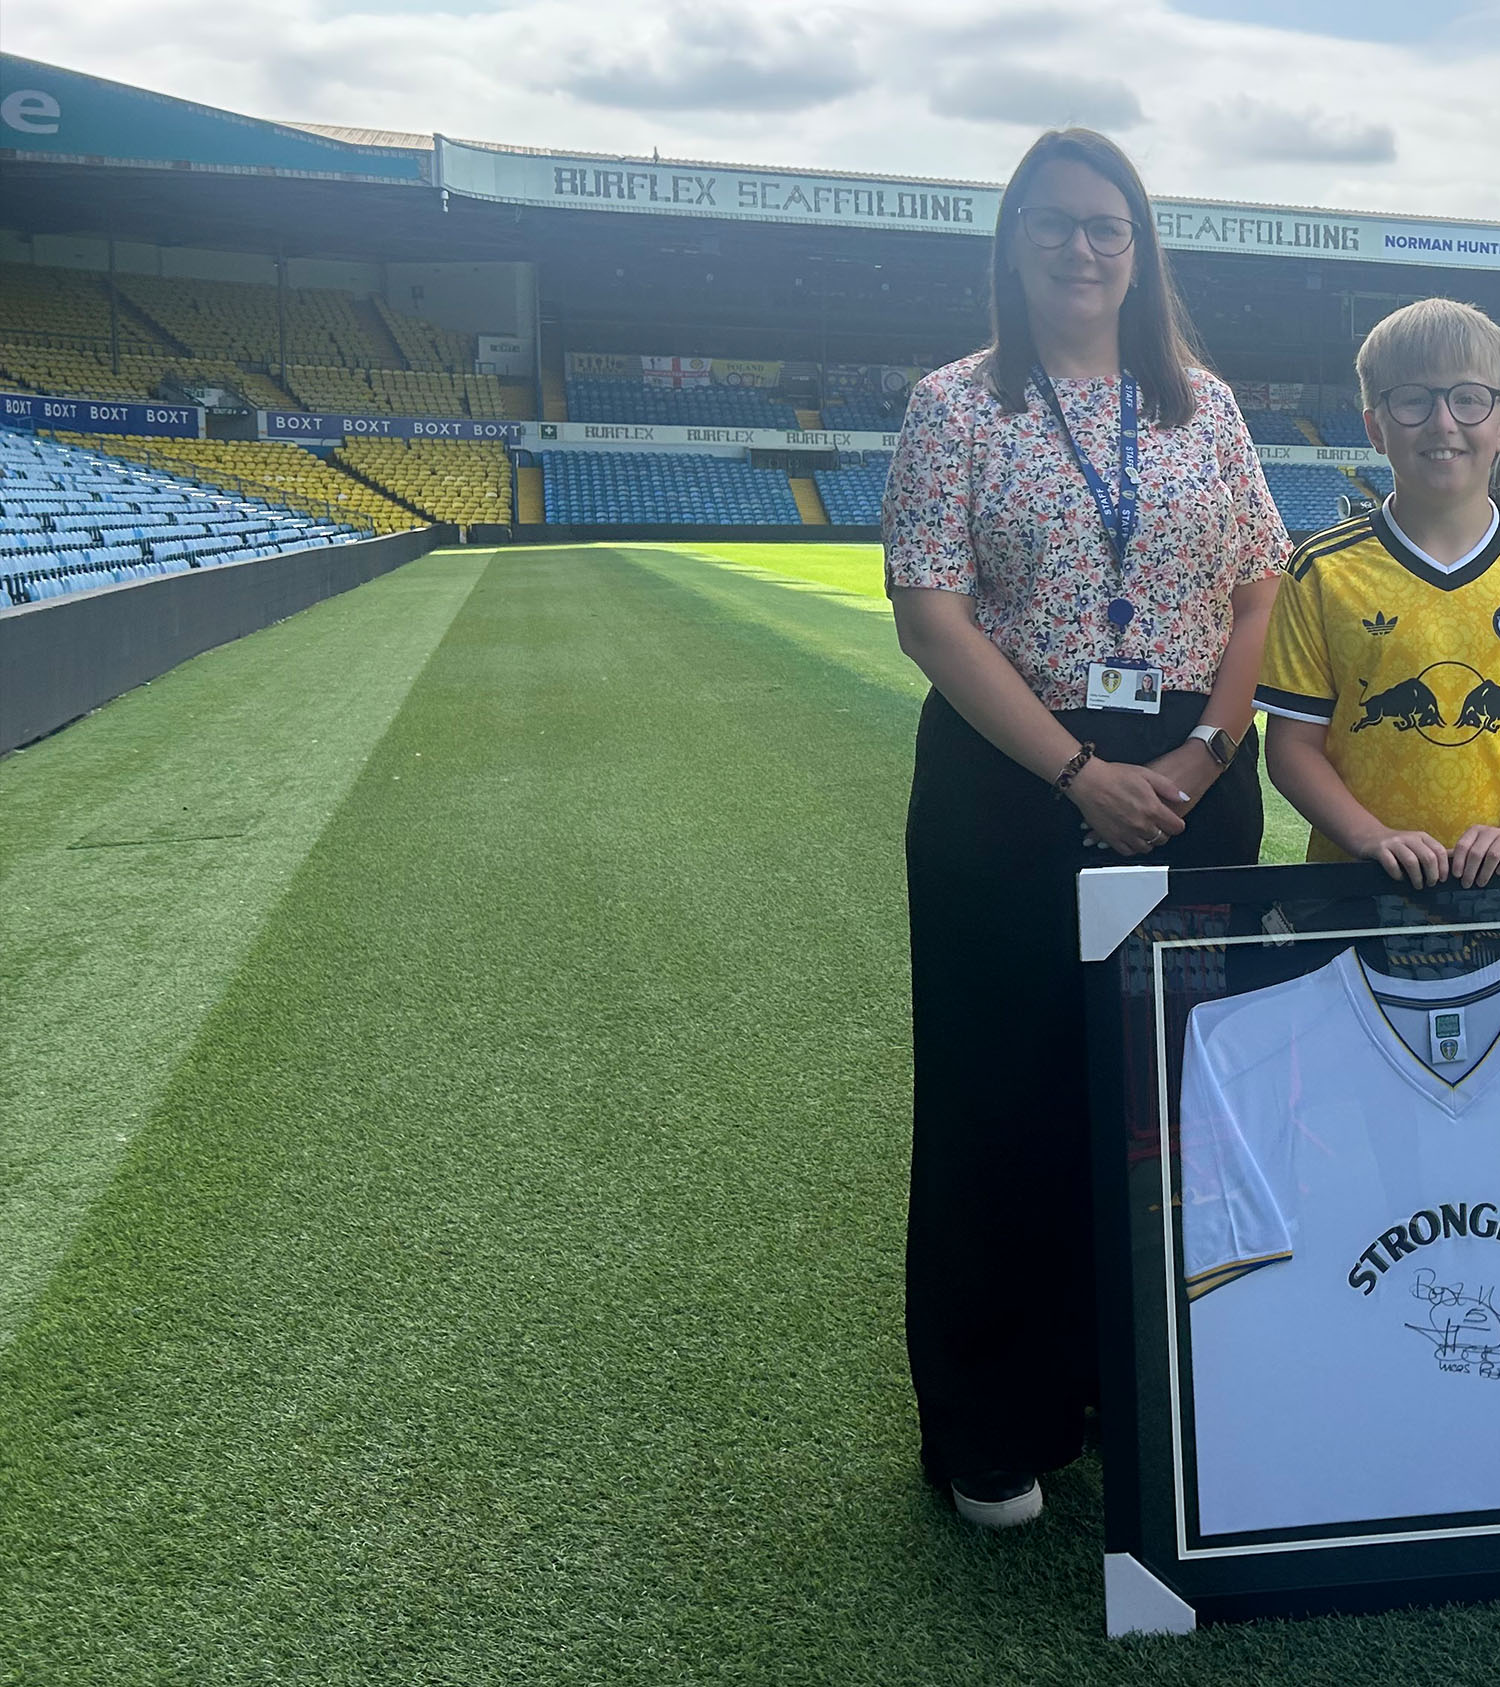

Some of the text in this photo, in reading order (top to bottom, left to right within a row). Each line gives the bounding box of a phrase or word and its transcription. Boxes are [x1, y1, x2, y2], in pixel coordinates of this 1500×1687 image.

[1, 90, 61, 134] e
[554, 166, 974, 223] BURFLEX SCAFFOLDING
[1156, 211, 1360, 251] SCAFFOLDING
[1384, 235, 1453, 253] NORMAN
[6, 399, 32, 416] BOXT
[44, 402, 77, 419] BOXT
[90, 406, 128, 422] BOXT
[146, 409, 188, 425] BOXT
[275, 416, 323, 431] BOXT
[343, 419, 391, 433] BOXT
[414, 422, 462, 436] BOXT
[473, 424, 520, 437] BOXT
[585, 426, 654, 441] BURFLEX
[687, 428, 754, 444] BURFLEX
[786, 432, 850, 446] BURFLEX
[1316, 449, 1370, 461] BURFLEX
[1096, 488, 1111, 516] STAFF
